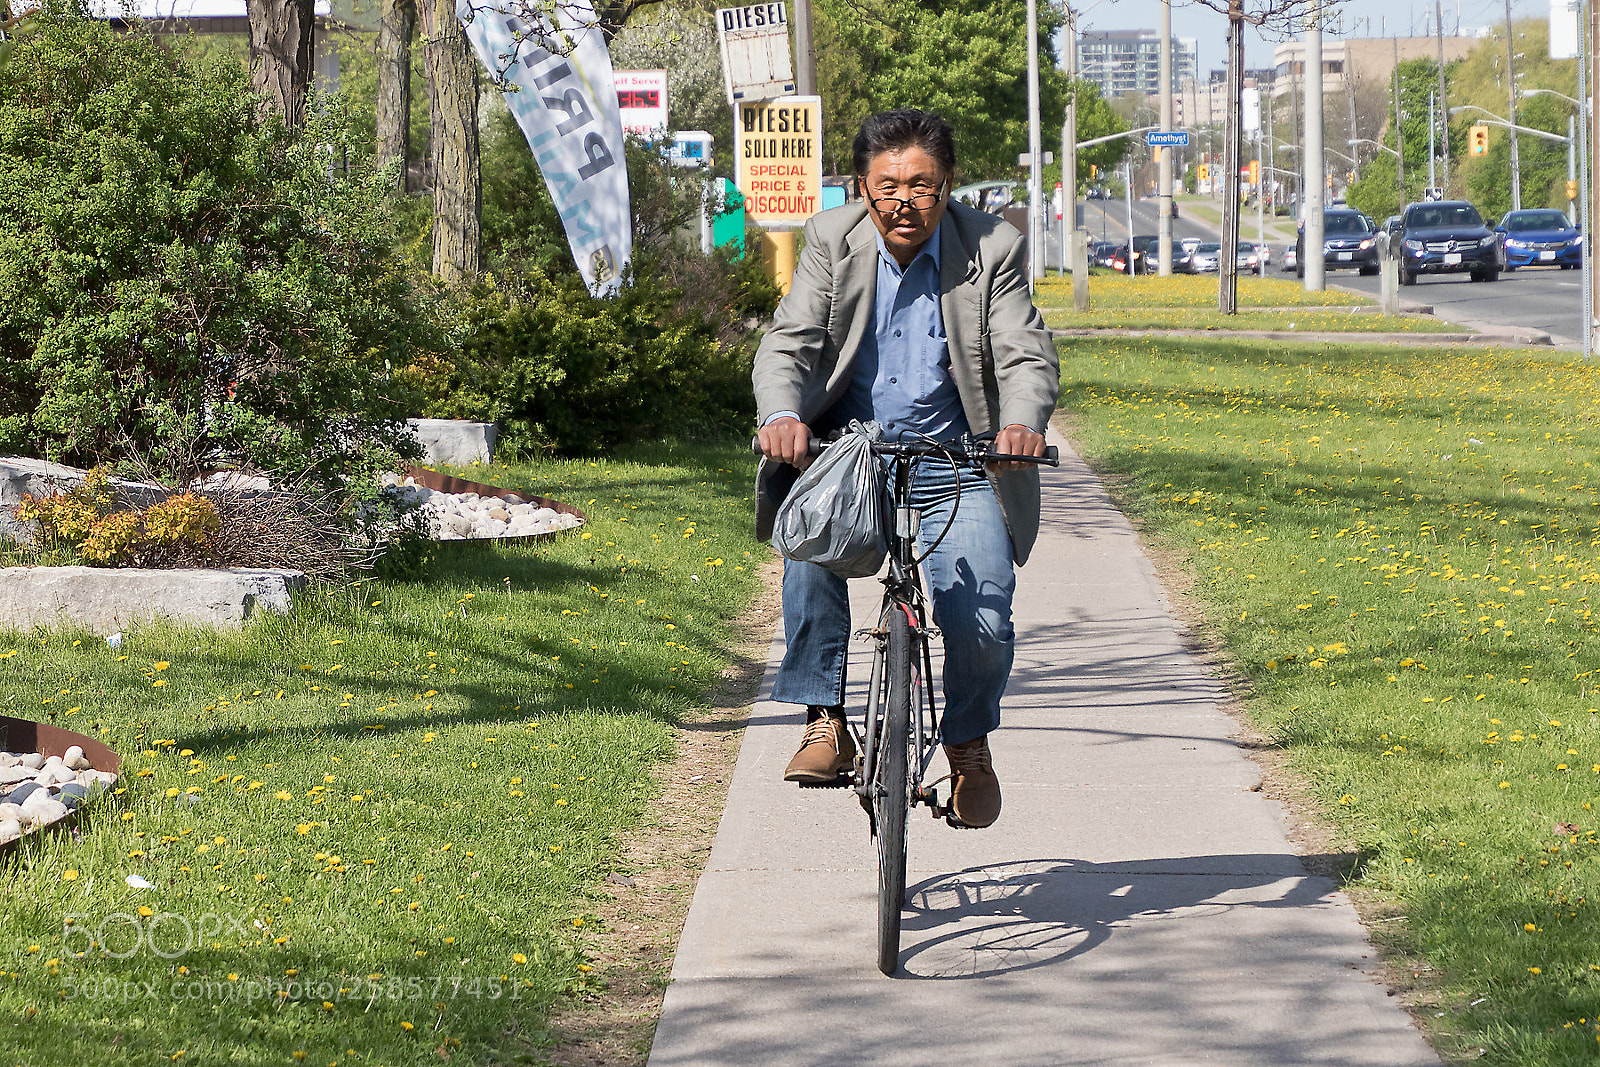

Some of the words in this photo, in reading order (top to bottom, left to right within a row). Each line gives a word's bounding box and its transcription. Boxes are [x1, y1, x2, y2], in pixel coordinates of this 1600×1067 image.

[723, 3, 786, 31] DIESEL
[614, 77, 628, 85] elf
[632, 77, 660, 85] Serve
[744, 108, 812, 132] DIESEL
[1150, 134, 1187, 144] Amethyst
[745, 139, 777, 158] SOLD
[782, 139, 812, 158] HERE
[750, 165, 807, 176] SPECIAL
[751, 181, 791, 191] PRICE
[797, 180, 806, 191] &
[745, 196, 815, 213] DISCOUNT
